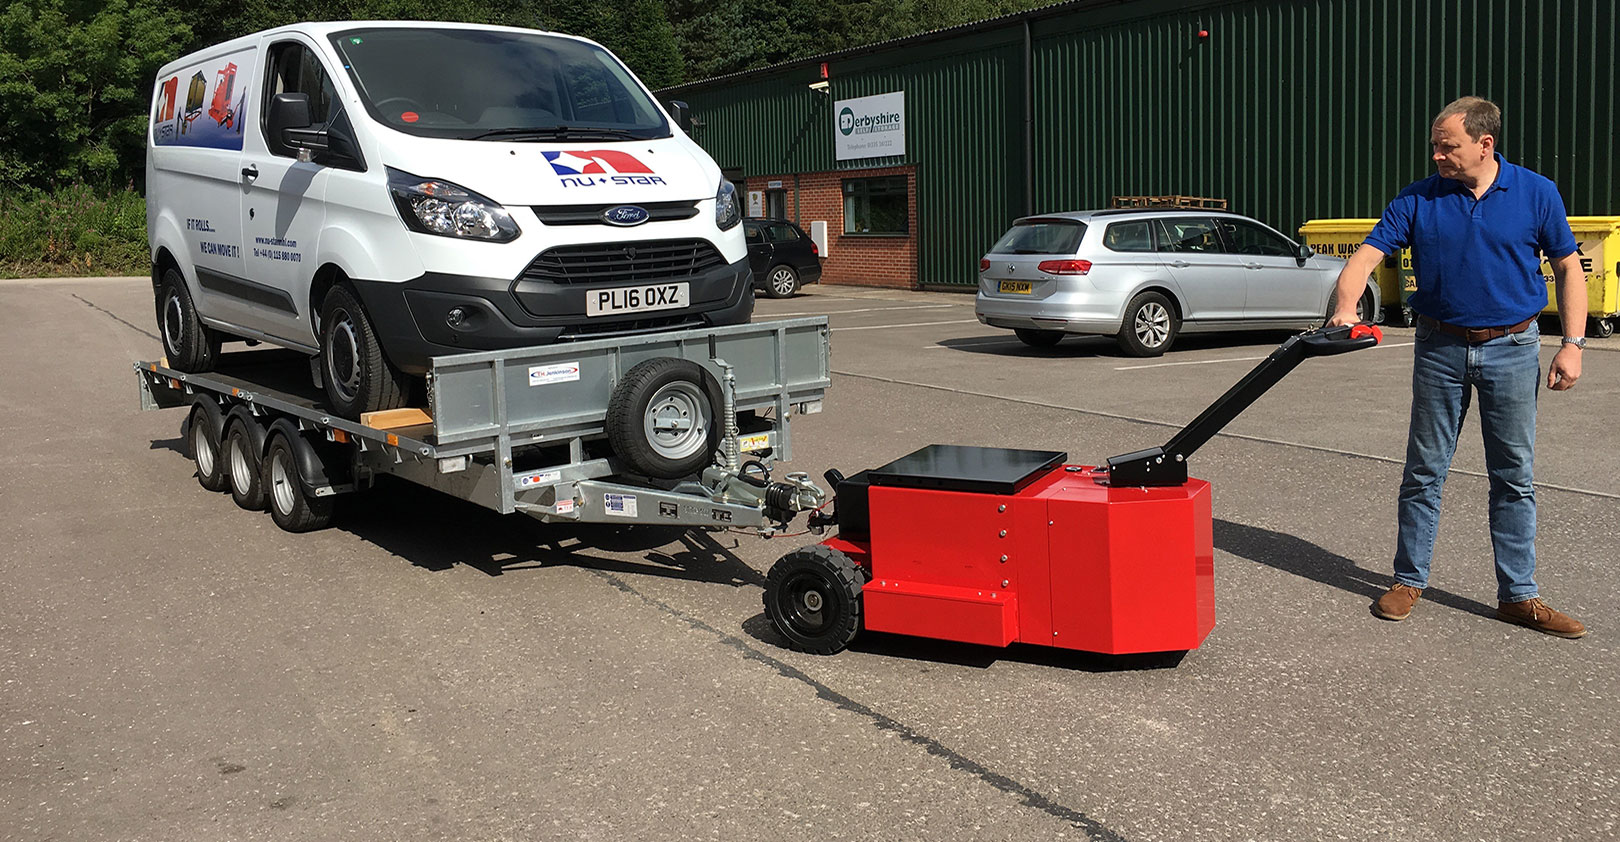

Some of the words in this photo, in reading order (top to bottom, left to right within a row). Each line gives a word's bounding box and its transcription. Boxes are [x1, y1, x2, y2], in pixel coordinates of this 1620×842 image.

[839, 107, 900, 136] Derbyshire
[615, 207, 641, 220] Ford
[200, 241, 208, 254] WE
[207, 242, 217, 255] CAN
[217, 243, 231, 258] MOVE
[231, 245, 236, 258] IT
[1310, 243, 1334, 254] PEAK
[1337, 243, 1361, 255] WAS
[598, 289, 640, 311] PL16
[645, 285, 679, 307] OXZ
